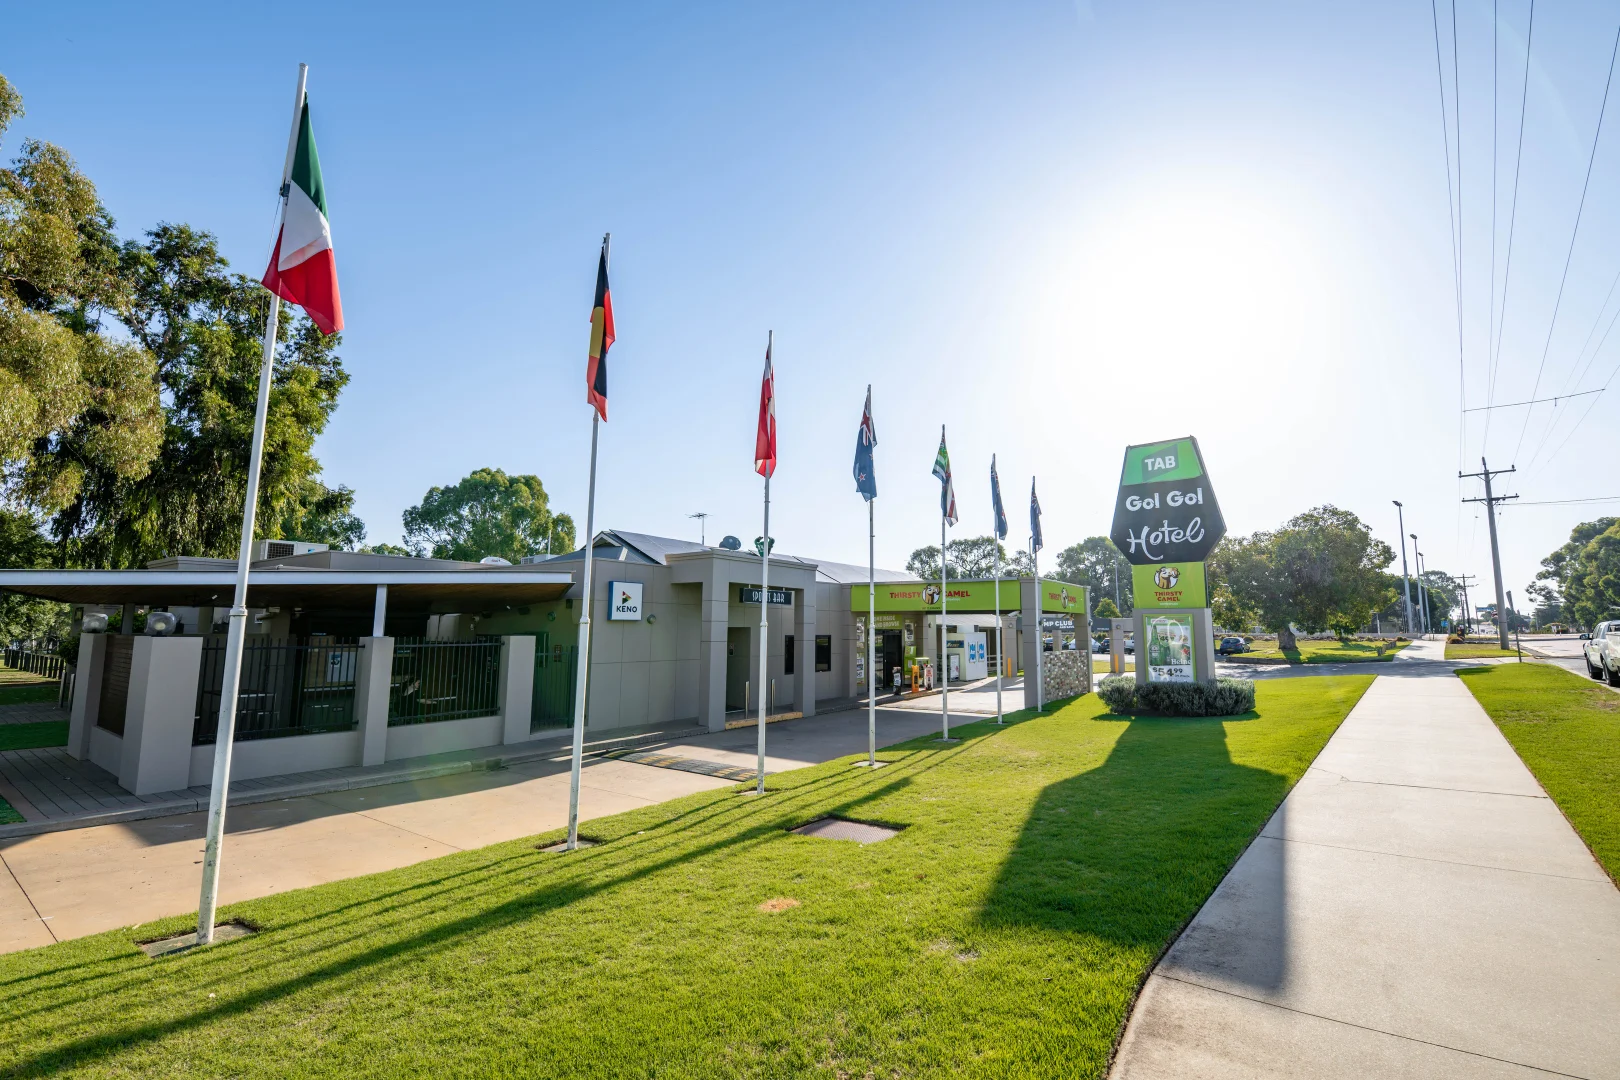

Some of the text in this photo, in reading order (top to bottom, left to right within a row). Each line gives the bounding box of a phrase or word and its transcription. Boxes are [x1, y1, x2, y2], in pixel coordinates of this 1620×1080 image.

[1145, 455, 1176, 471] TAB
[1125, 488, 1203, 512] Gol Gol
[1126, 517, 1205, 560] Hotel
[773, 592, 785, 603] BAR
[616, 605, 638, 613] KENO
